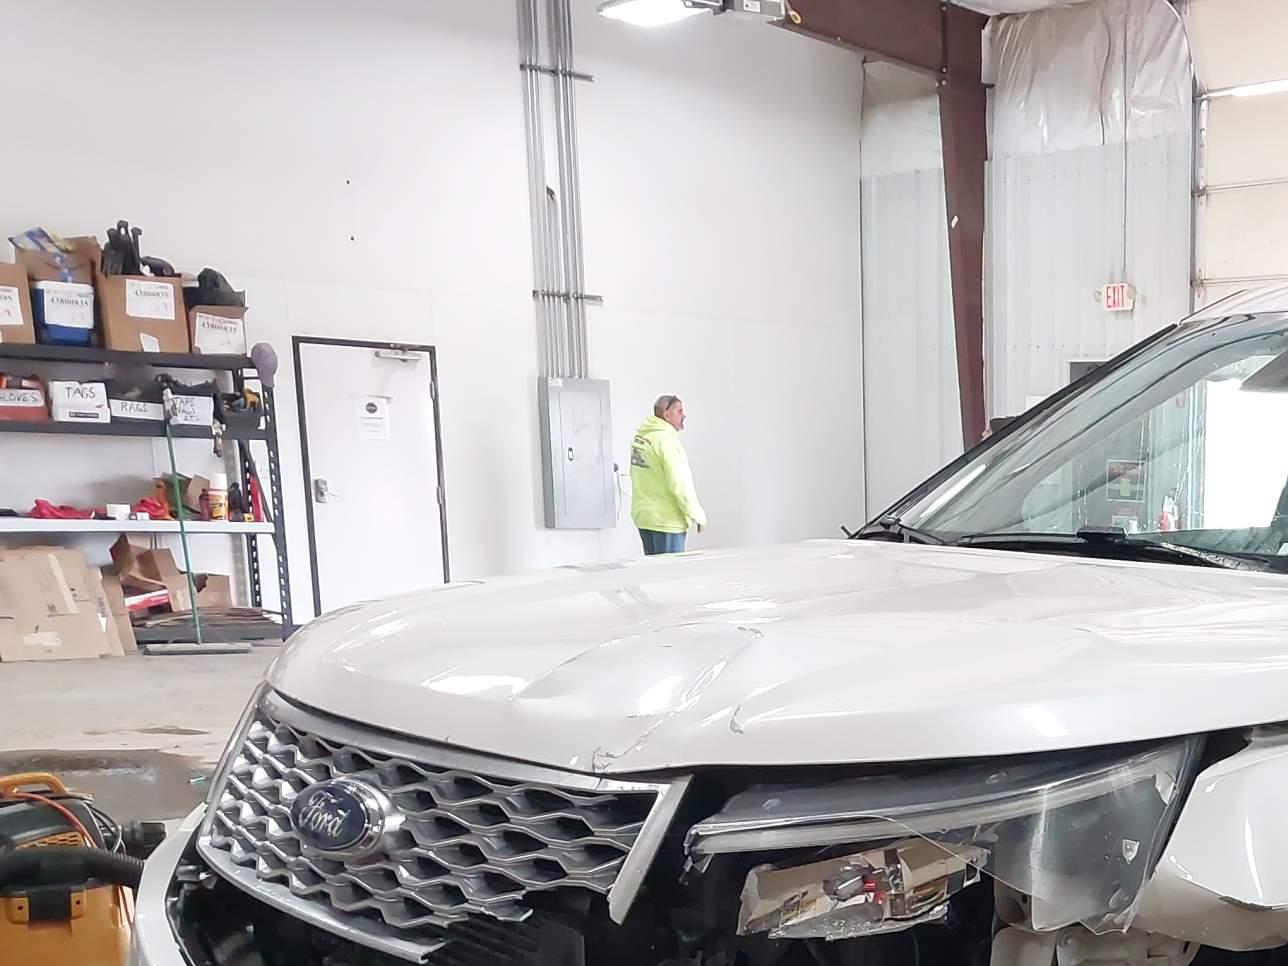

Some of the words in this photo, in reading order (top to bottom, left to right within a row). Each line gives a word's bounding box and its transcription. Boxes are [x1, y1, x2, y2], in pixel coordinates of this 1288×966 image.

[1106, 285, 1125, 308] EXIT
[65, 386, 96, 400] TAGS
[121, 401, 148, 413] RAGS
[299, 790, 352, 838] Ford
